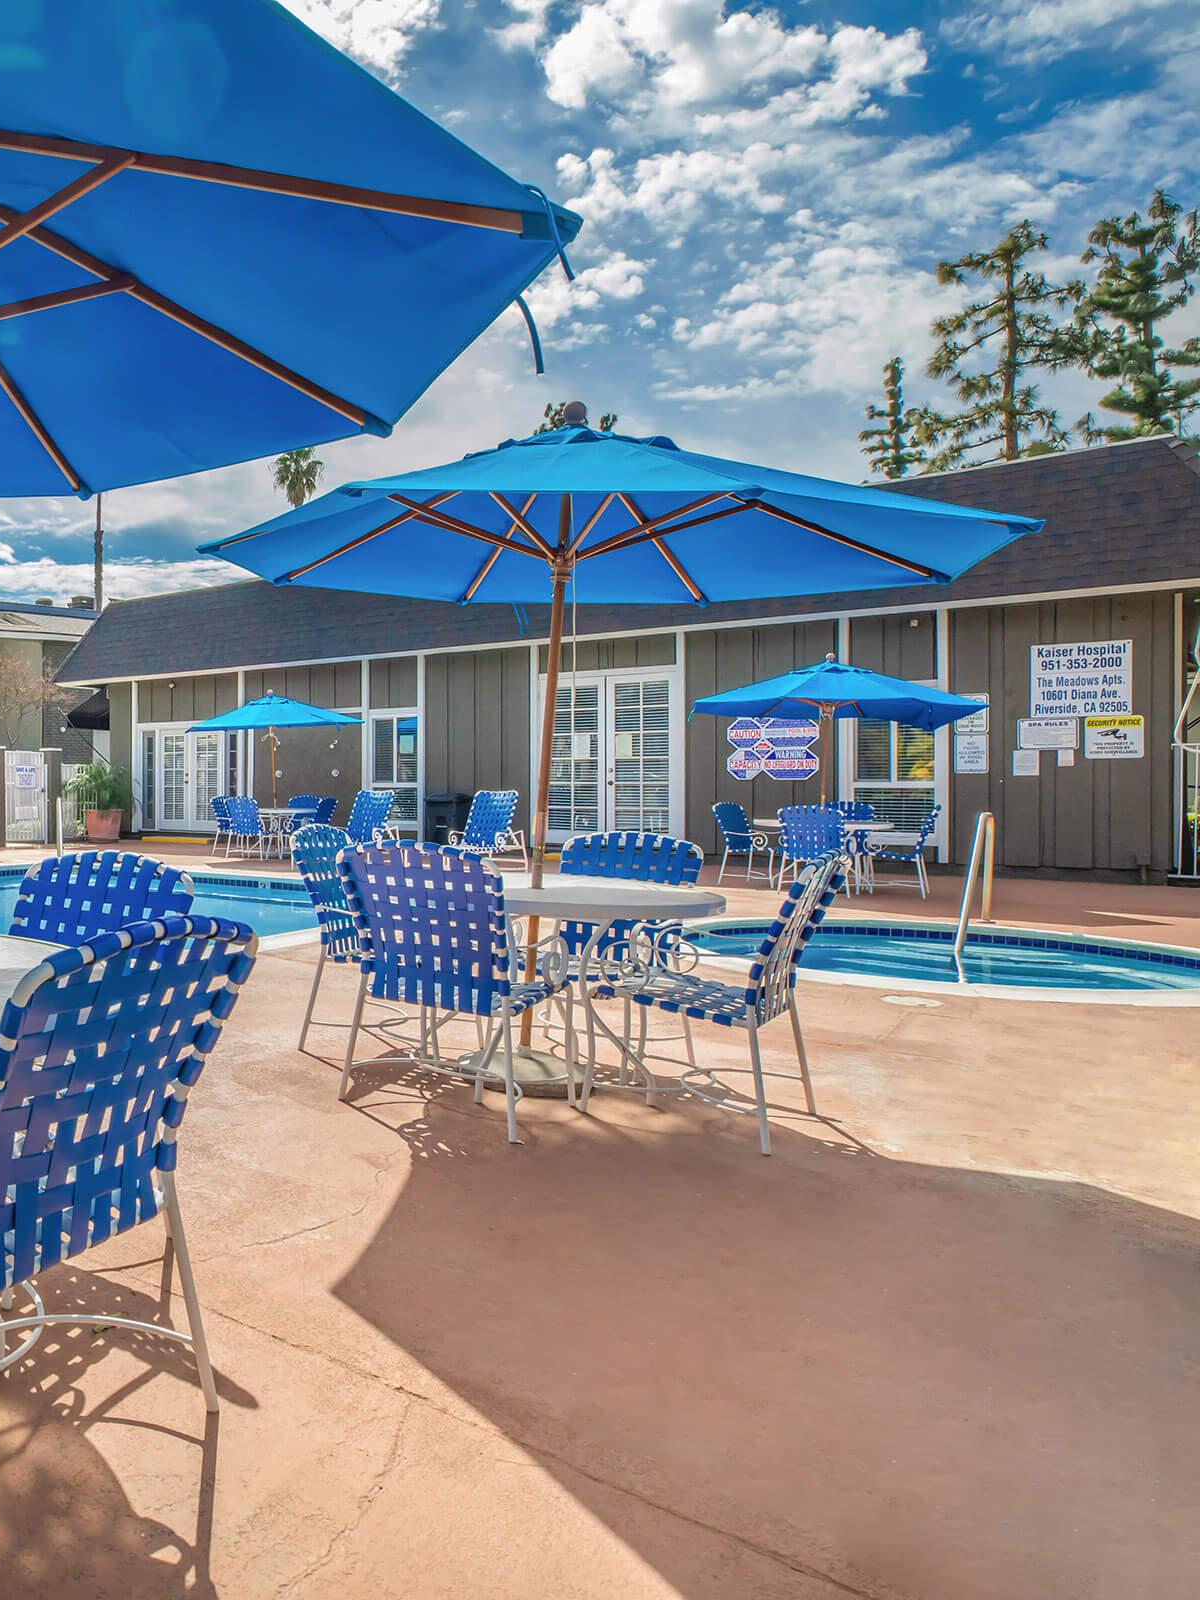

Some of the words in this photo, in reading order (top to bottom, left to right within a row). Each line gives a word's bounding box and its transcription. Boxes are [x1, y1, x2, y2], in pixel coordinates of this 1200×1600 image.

[1037, 647, 1073, 658] Kaiser
[1077, 643, 1126, 656] Hospital
[1041, 656, 1122, 671] 951-353-2000
[1037, 677, 1053, 688] The
[1056, 675, 1099, 687] Meadows
[1101, 674, 1125, 686] Apts.
[1041, 690, 1067, 701] 10601
[1071, 689, 1098, 700] Diana
[1101, 688, 1121, 699] Ave.
[1084, 702, 1097, 713] CA
[1099, 701, 1128, 713] 92505
[1087, 719, 1118, 727] SECURITY
[1118, 718, 1141, 726] NOTICE
[729, 729, 761, 739] CAUTION
[775, 750, 806, 759] WARNING
[729, 760, 762, 769] CAPACITY
[764, 760, 771, 768] NO
[772, 760, 796, 768] LIFEGUARD
[797, 760, 804, 768] ON
[805, 760, 817, 768] DUTY
